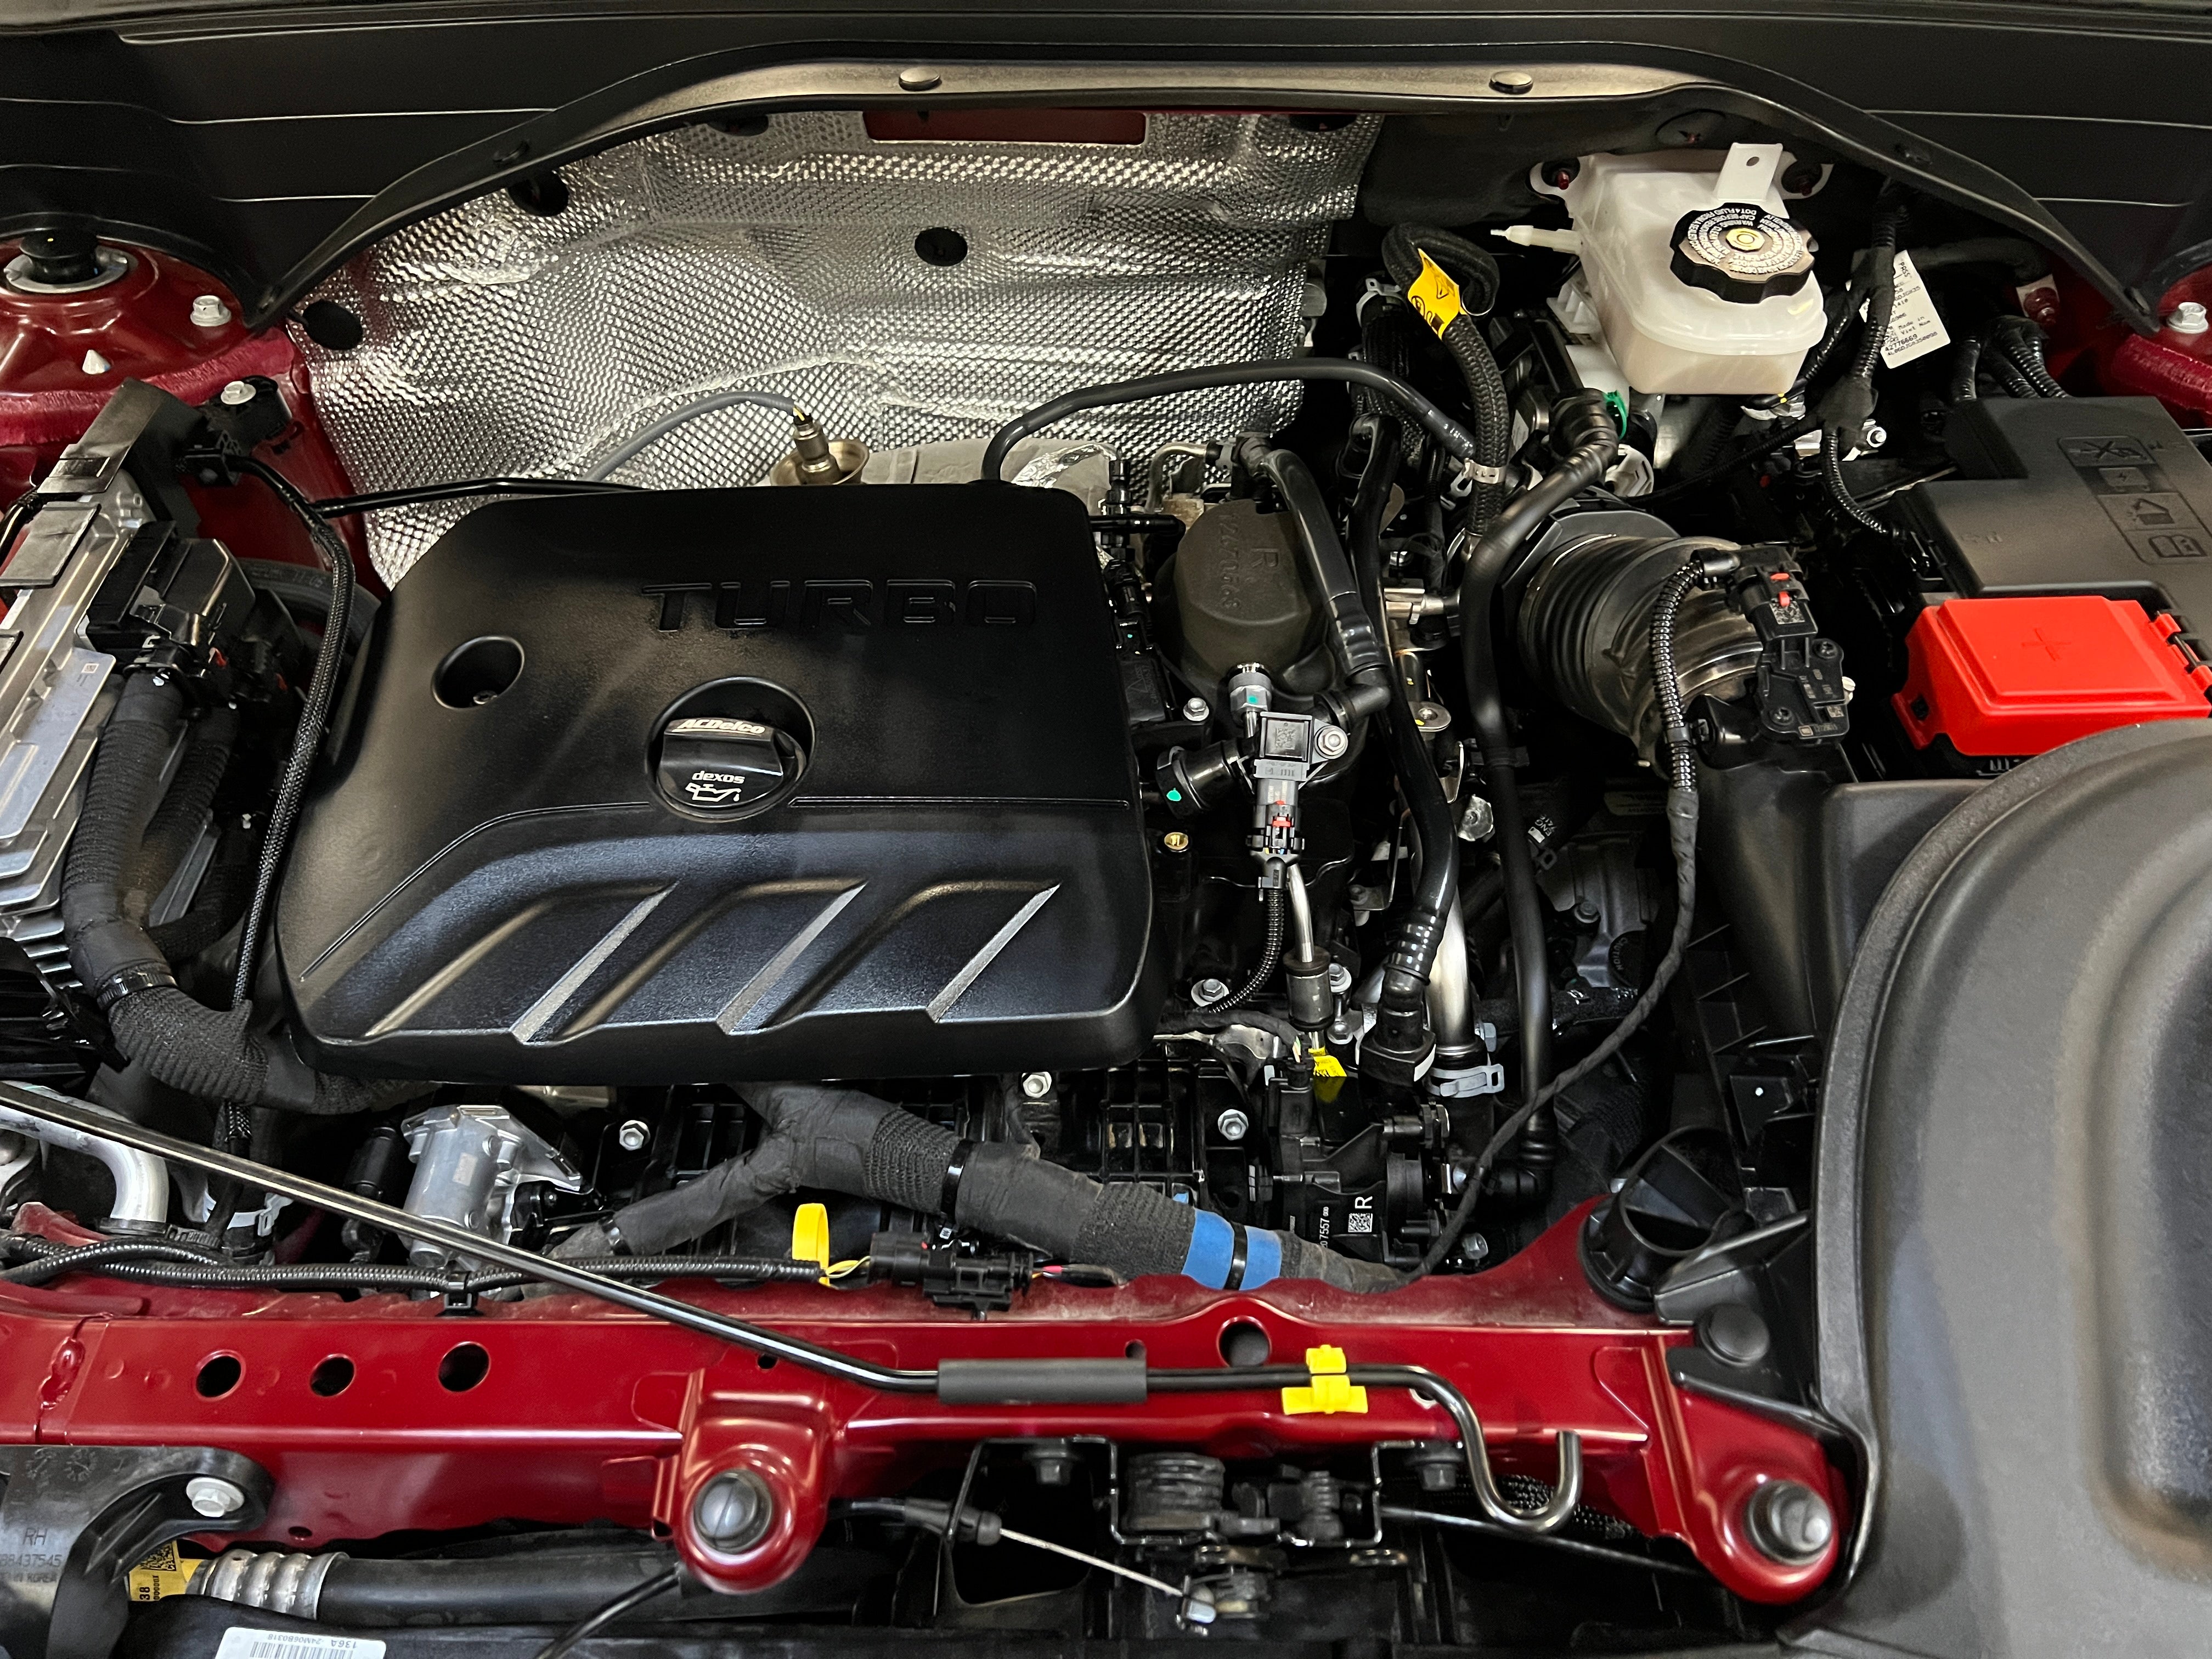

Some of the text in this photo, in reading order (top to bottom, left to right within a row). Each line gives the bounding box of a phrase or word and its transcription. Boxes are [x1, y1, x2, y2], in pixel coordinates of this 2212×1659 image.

[641, 579, 1038, 632] TURBO
[676, 719, 766, 735] ACDelco
[691, 769, 746, 785] dexos
[1354, 1195, 1373, 1210] R
[22, 1527, 48, 1546] RH
